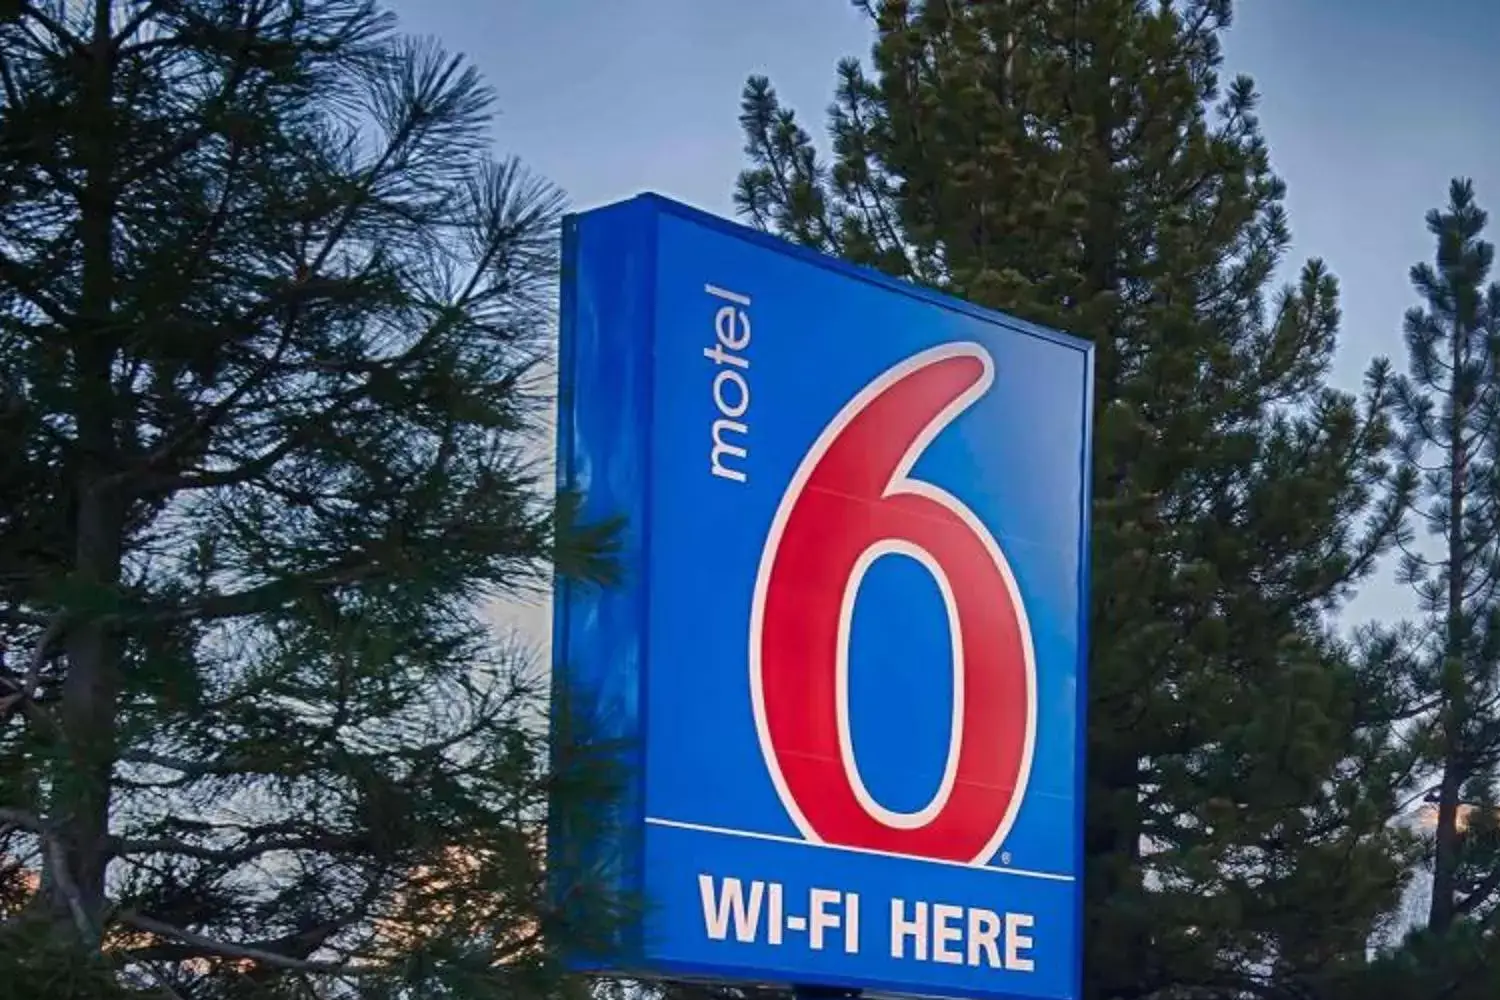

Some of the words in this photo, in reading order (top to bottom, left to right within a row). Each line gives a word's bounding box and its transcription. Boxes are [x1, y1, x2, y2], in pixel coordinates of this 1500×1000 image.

[704, 283, 753, 483] motel
[748, 341, 1039, 868] 6
[698, 874, 860, 954] WI-FI
[890, 898, 1035, 973] HERE
